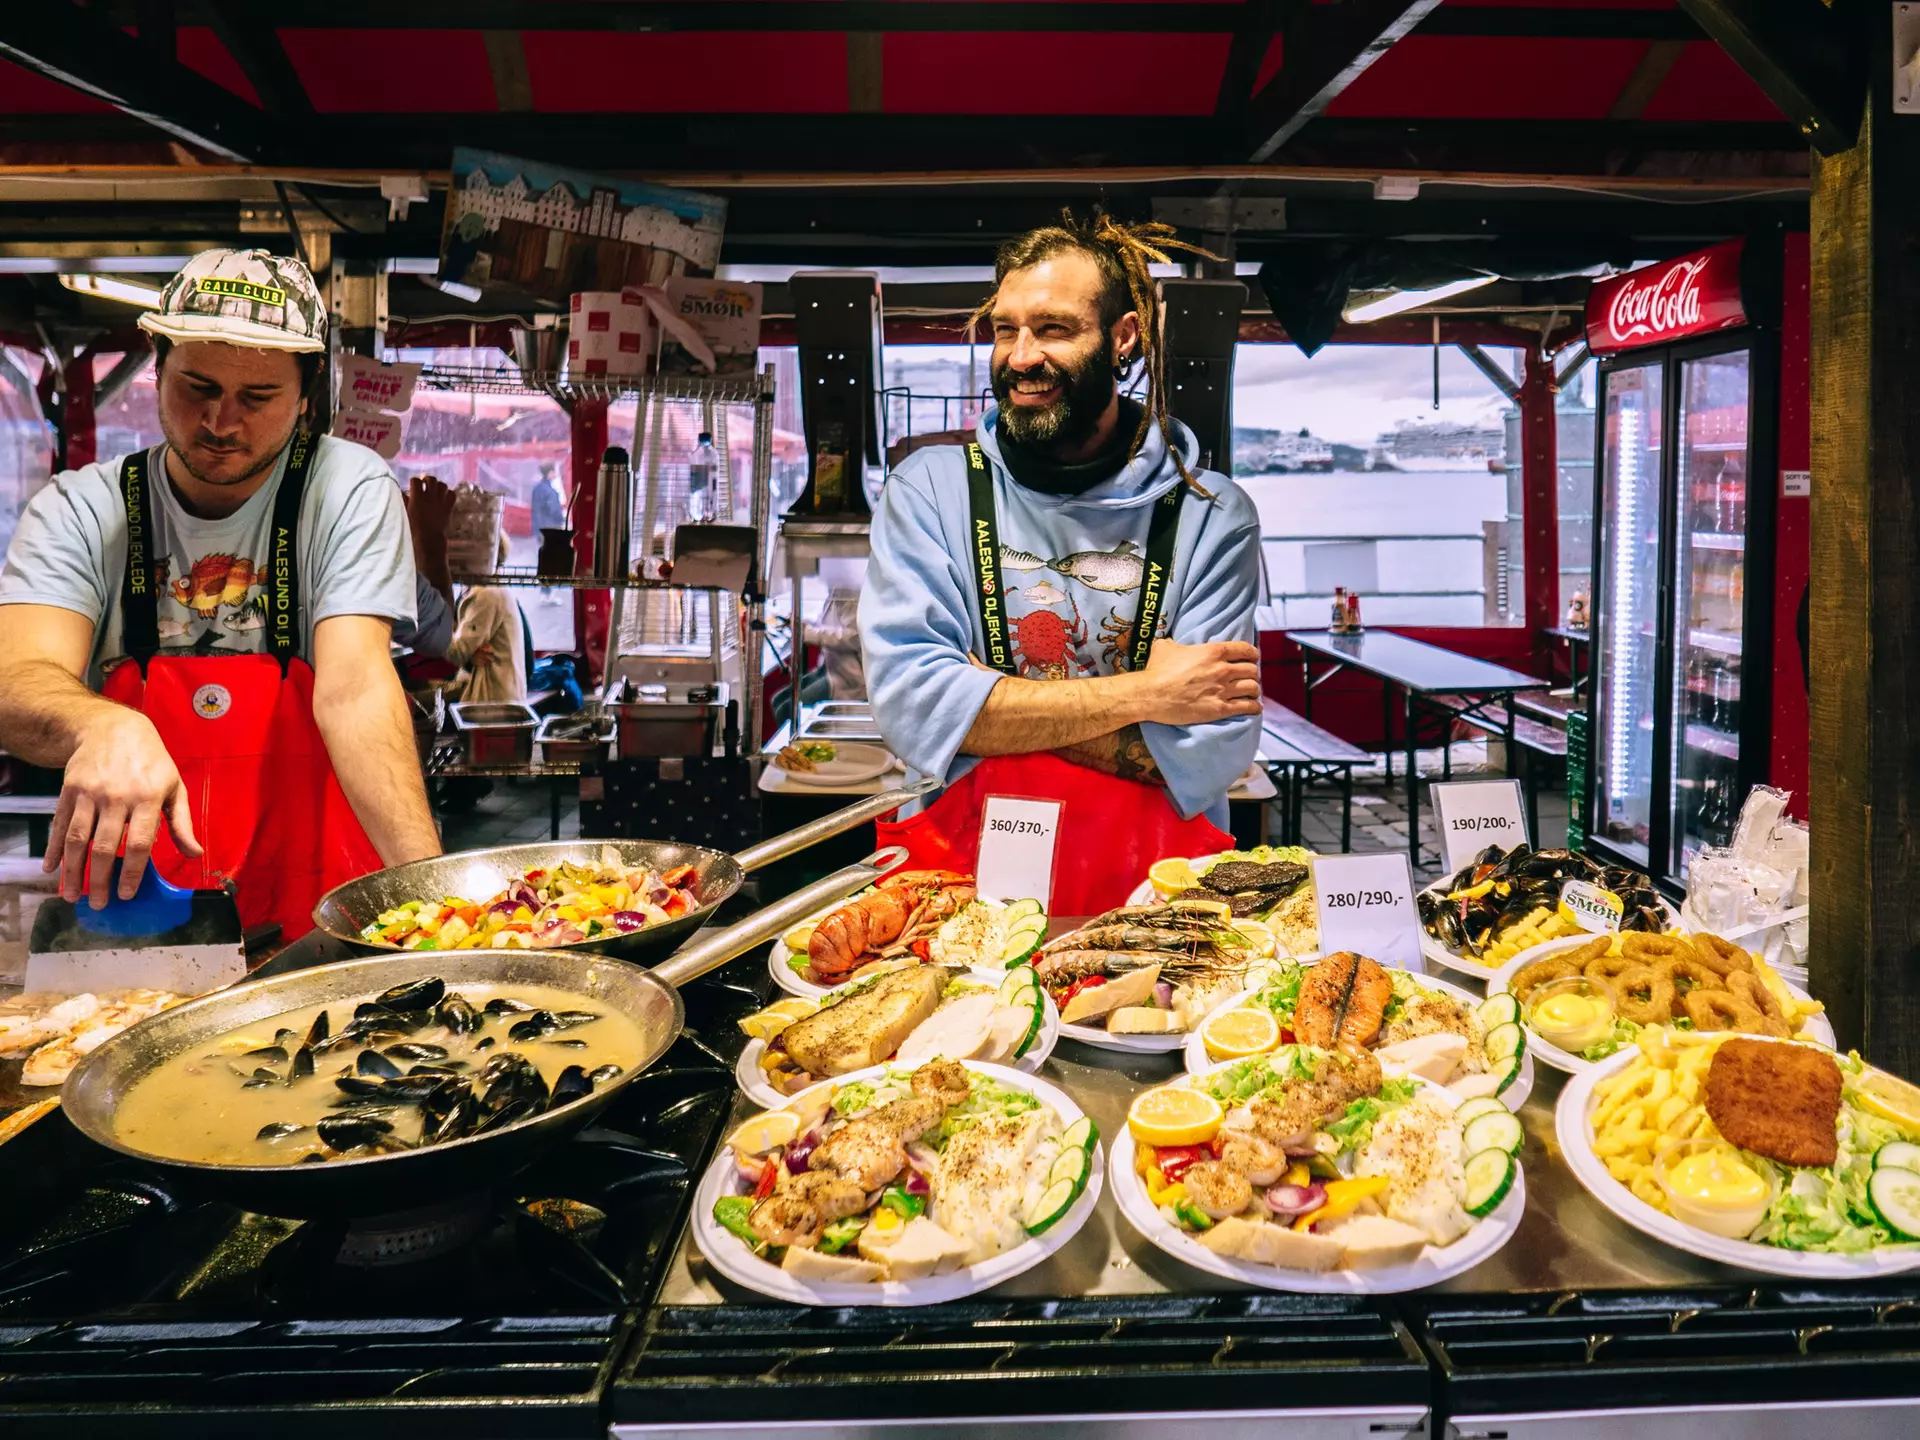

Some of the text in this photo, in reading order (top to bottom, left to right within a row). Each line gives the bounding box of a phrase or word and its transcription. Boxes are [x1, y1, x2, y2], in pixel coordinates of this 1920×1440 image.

[203, 281, 279, 302] CALI CLUB
[1608, 256, 1711, 342] Coca-Cola
[352, 378, 402, 396] MILF
[343, 427, 390, 442] MILF
[127, 466, 141, 524] AALESUND
[276, 527, 289, 610] AALESUND
[1139, 561, 1163, 638] AALESUND
[984, 597, 1005, 665] OLJEKLED
[990, 819, 1050, 837] 360/370,-
[1452, 817, 1516, 831] 190/200,-
[1326, 891, 1404, 908] 280/290,-
[1565, 893, 1619, 923] SMØR
